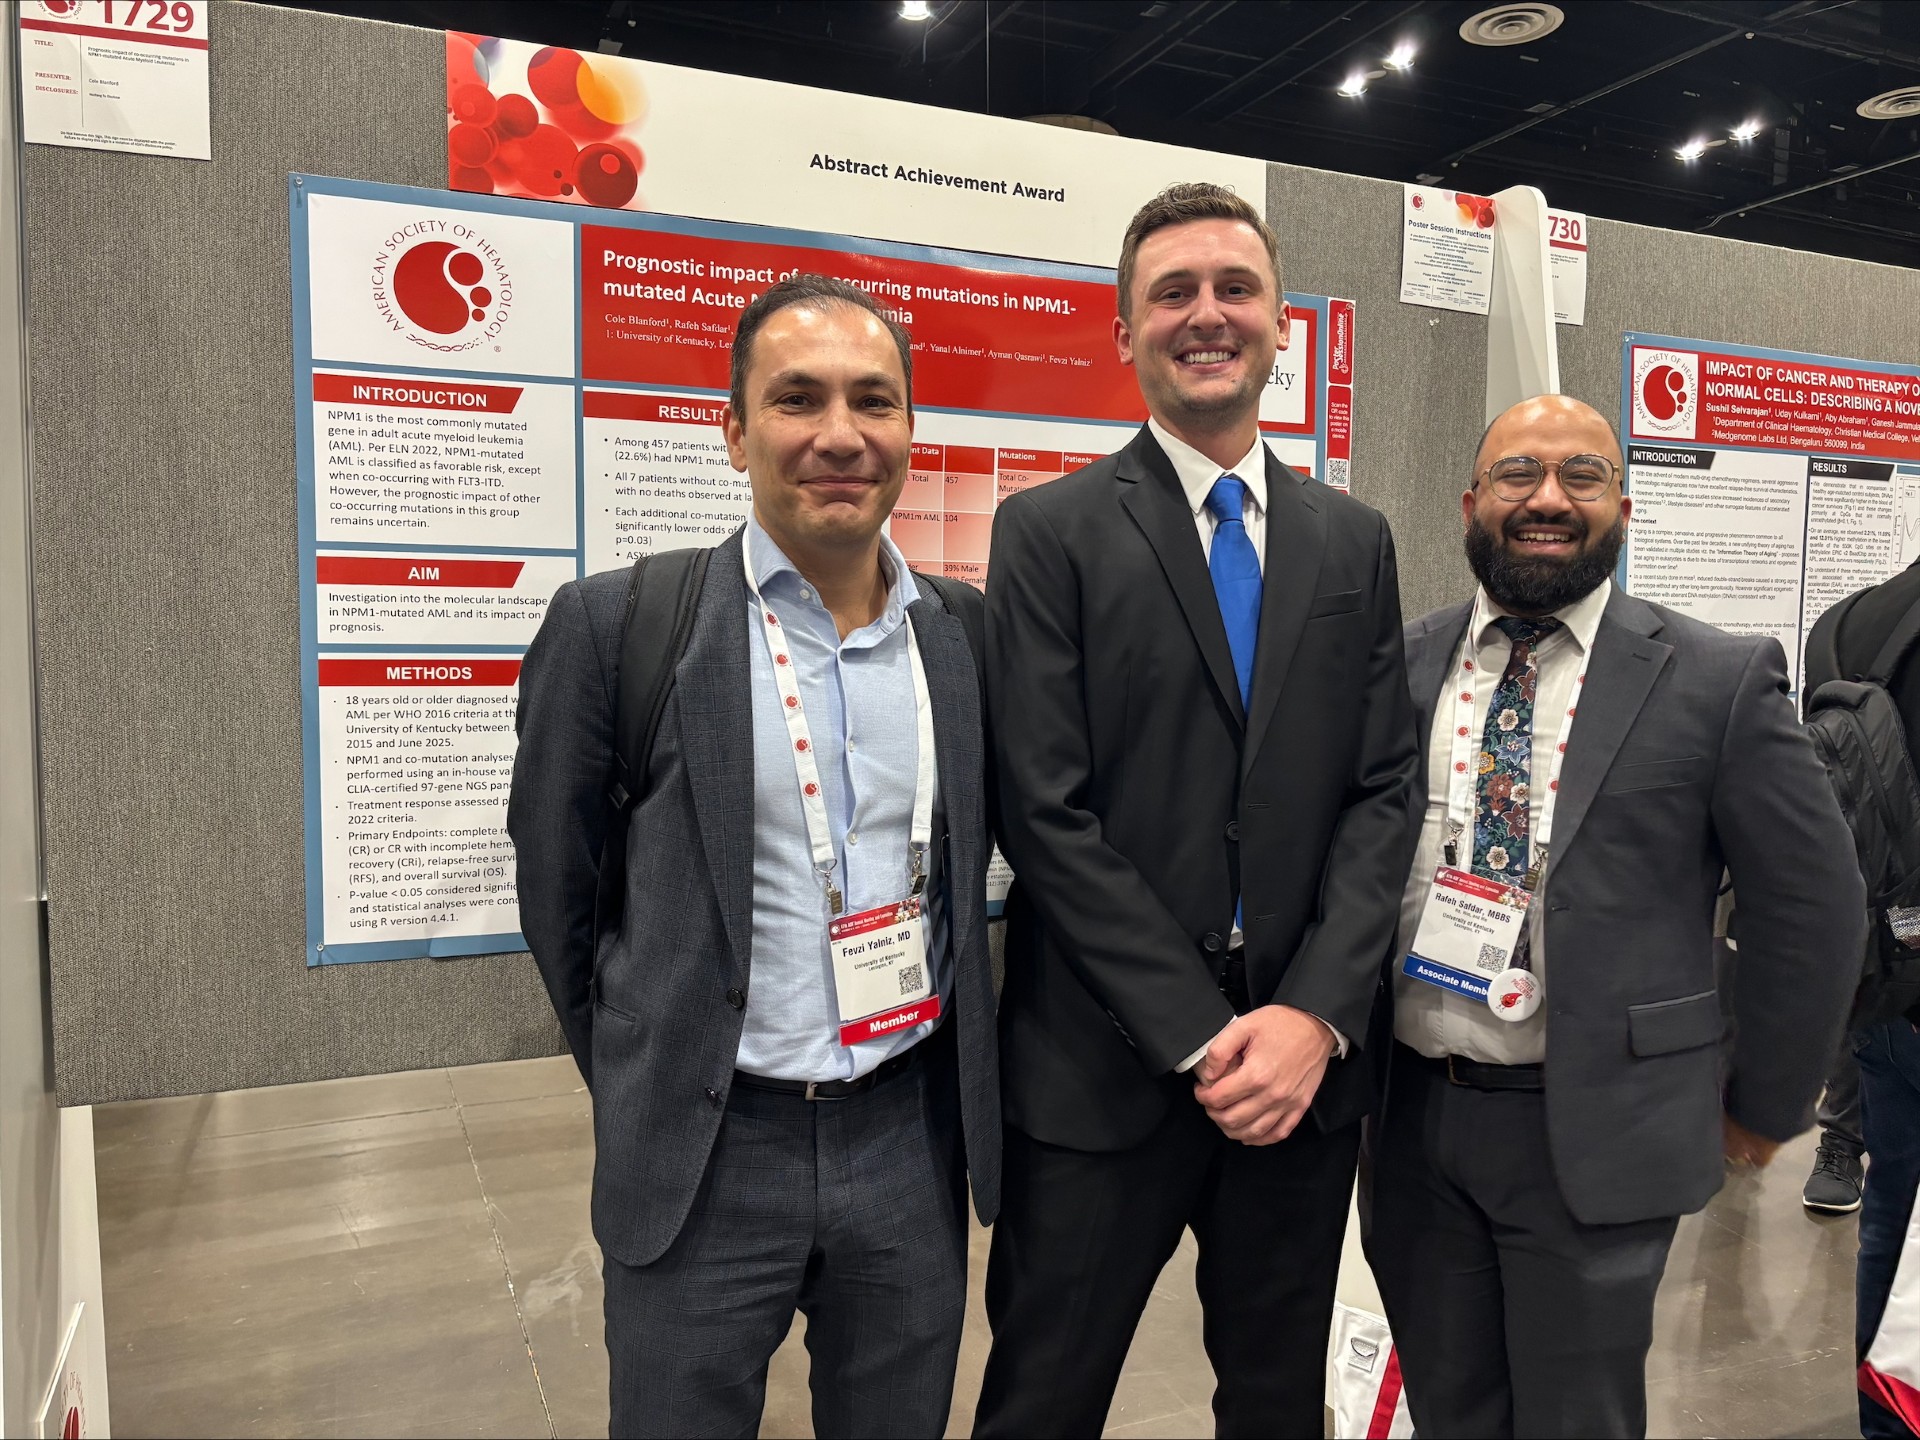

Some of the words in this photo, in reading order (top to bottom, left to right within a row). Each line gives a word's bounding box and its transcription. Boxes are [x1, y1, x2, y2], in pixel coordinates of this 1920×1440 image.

[97, 0, 194, 32] 1729
[35, 72, 71, 80] PRESENTER:
[35, 86, 78, 95] DISCLOSURES:
[810, 154, 888, 178] Abstract
[894, 166, 1007, 194] Achievement
[1012, 182, 1065, 202] Award
[385, 220, 446, 251] SOCIETY
[454, 224, 475, 240] OF
[1409, 220, 1428, 230] Poster
[1431, 224, 1454, 234] Session
[1456, 227, 1491, 240] Instructions
[1548, 216, 1580, 241] 730
[372, 252, 404, 331] AMERICAN
[477, 239, 512, 341] HEMATOLOGY
[604, 250, 704, 276] Prognostic
[709, 261, 773, 284] impact
[779, 268, 799, 283] of
[916, 287, 999, 307] mutations
[1003, 292, 1018, 309] in
[1023, 296, 1077, 315] NPM1-
[604, 282, 685, 302] mutated
[692, 288, 745, 308] Acute
[605, 314, 625, 324] Cole
[675, 320, 699, 331] Rafeh
[616, 331, 660, 343] University
[664, 335, 674, 343] of
[675, 335, 717, 349] Kentucky,
[930, 344, 950, 353] Yanal
[988, 350, 1012, 360] Ayman
[1049, 355, 1067, 365] Fevzi
[1640, 353, 1668, 372] SOCIETY
[1671, 355, 1681, 364] OF
[1706, 360, 1753, 378] IMPACT
[1756, 367, 1773, 381] OF
[1776, 369, 1827, 387] CANCER
[1830, 374, 1854, 390] AND
[1856, 377, 1909, 395] THERAPY
[353, 385, 487, 407] INTRODUCTION
[1634, 373, 1647, 419] AMERICAN
[1681, 363, 1696, 424] HEMATOLOGY
[1706, 382, 1760, 400] NORMAL
[1764, 388, 1807, 405] CELLS:
[1811, 392, 1882, 411] DESCRIBING
[1885, 400, 1892, 413] A
[1895, 400, 1920, 416] NOVE
[328, 411, 361, 422] NPM1
[366, 413, 373, 422] is
[377, 414, 393, 423] the
[398, 416, 424, 426] most
[427, 417, 482, 430] commonly
[485, 421, 527, 431] mutated
[1706, 402, 1729, 414] Sushil
[1775, 409, 1792, 420] Uday
[1825, 414, 1837, 424] Aby
[1871, 418, 1894, 428] Ganesh
[328, 427, 355, 437] gene
[358, 427, 368, 436] in
[372, 429, 398, 439] adult
[401, 431, 430, 440] acute
[434, 432, 474, 443] myeloid
[477, 434, 524, 446] leukemia
[615, 437, 649, 449] Among
[652, 439, 669, 448] 457
[672, 441, 710, 451] patients
[1759, 434, 1774, 443] Labs
[1790, 436, 1822, 446] Bengaluru
[1851, 442, 1865, 450] India
[329, 441, 364, 453] (AML).
[369, 443, 385, 453] Per
[389, 444, 409, 454] ELN
[412, 445, 441, 456] 2022,
[445, 447, 524, 460] NPM1-mutated
[615, 451, 651, 462] (22.6%)
[654, 454, 671, 463] had
[675, 455, 703, 465] NPM1
[922, 447, 939, 455] Data
[1000, 452, 1036, 461] Mutations
[1065, 455, 1092, 464] Patients
[1633, 451, 1696, 464] INTRODUCTION
[329, 456, 354, 466] AML
[357, 457, 365, 466] is
[368, 457, 416, 469] classified
[419, 461, 430, 470] as
[434, 460, 482, 472] favorable
[485, 463, 505, 474] risk,
[508, 465, 541, 475] except
[1813, 462, 1847, 473] RESULTS
[912, 474, 929, 483] Total
[945, 476, 958, 484] 457
[1000, 473, 1016, 482] Total
[1018, 474, 1029, 482] Co-
[892, 512, 921, 521] NPM1m
[924, 513, 940, 522] AML
[945, 514, 958, 522] 104
[408, 567, 439, 580] AIM
[944, 564, 959, 572] 39%
[961, 565, 979, 573] Male
[961, 576, 986, 584] Female
[329, 593, 397, 604] Investigation
[400, 595, 420, 604] into
[423, 595, 440, 604] the
[444, 595, 494, 605] molecular
[498, 596, 548, 607] landscape
[386, 667, 472, 680] METHODS
[346, 739, 372, 748] 2015
[376, 739, 395, 748] and
[398, 739, 422, 748] June
[425, 738, 454, 747] 2025.
[1435, 893, 1456, 906] Rafeh
[1459, 901, 1484, 916] Safdar,
[1488, 910, 1511, 923] MBBS
[843, 944, 864, 957] Fevzi
[868, 937, 895, 950] Yalniz,
[898, 931, 910, 942] MD
[1417, 966, 1459, 986] Associate
[870, 1010, 919, 1032] Member
